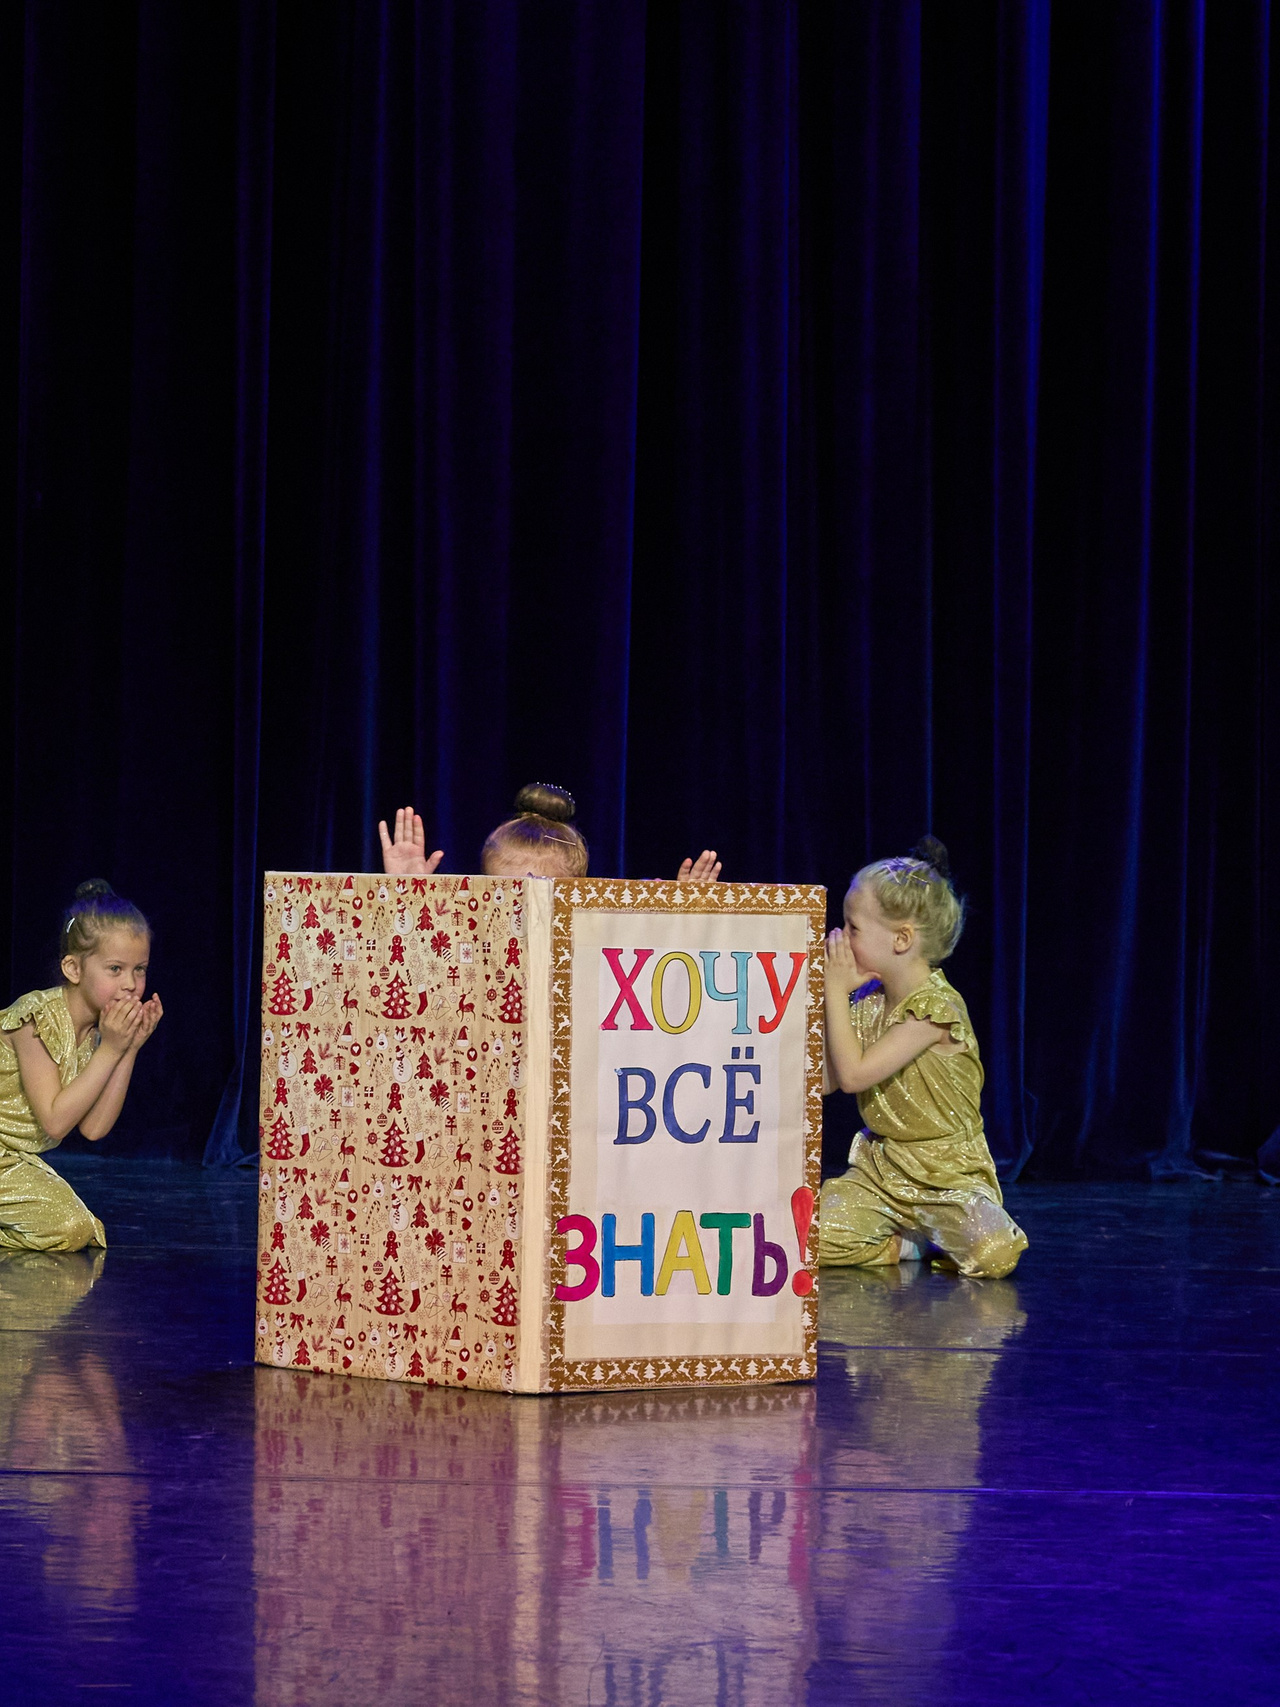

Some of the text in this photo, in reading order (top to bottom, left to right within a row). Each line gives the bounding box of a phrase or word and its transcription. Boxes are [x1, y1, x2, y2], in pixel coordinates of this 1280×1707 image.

[600, 948, 807, 1034] ХОЧУ
[613, 1046, 761, 1145] ВСЁ
[556, 1186, 814, 1302] ЗНАТЬ!
